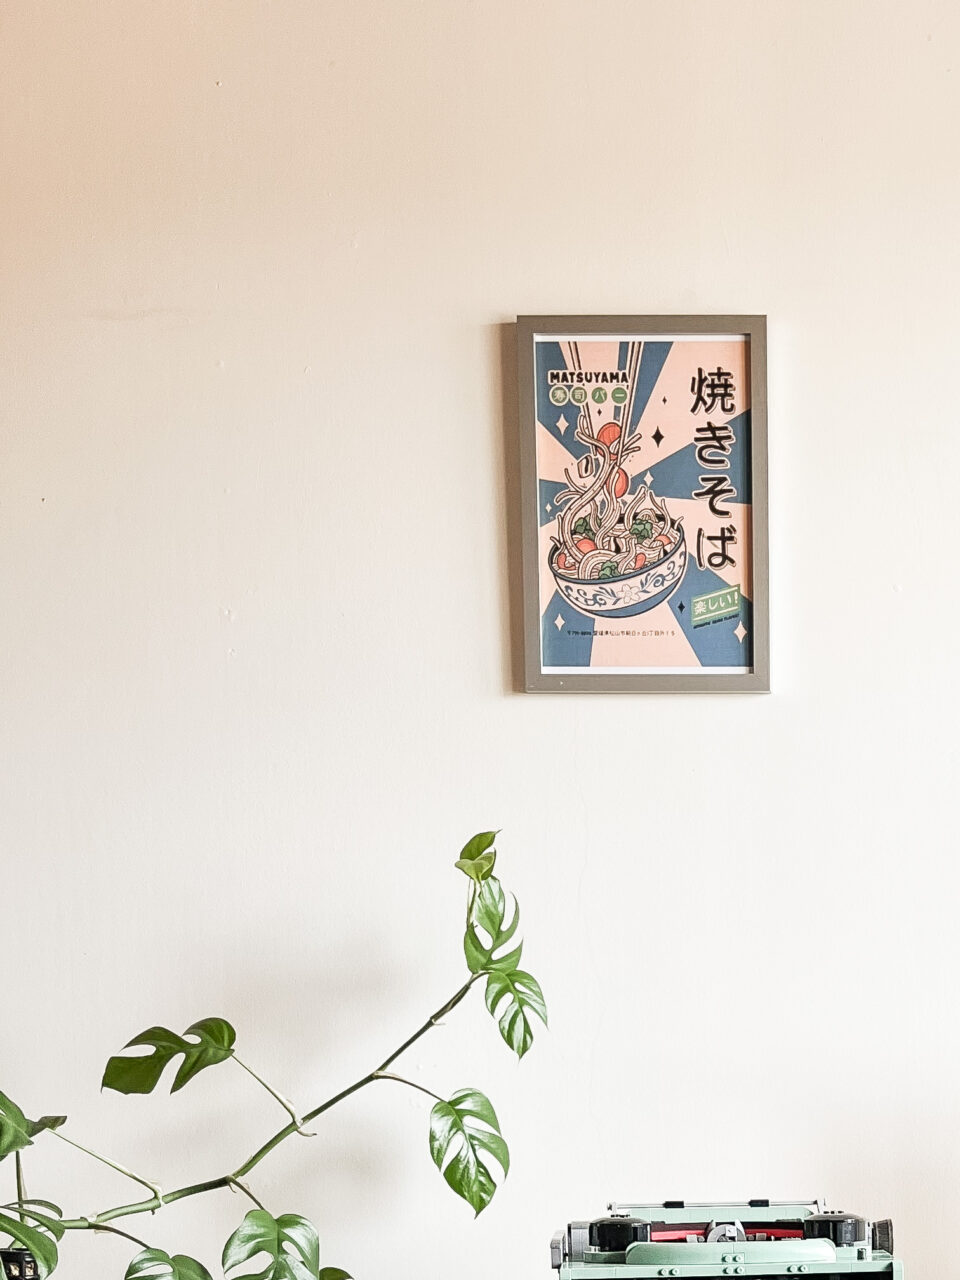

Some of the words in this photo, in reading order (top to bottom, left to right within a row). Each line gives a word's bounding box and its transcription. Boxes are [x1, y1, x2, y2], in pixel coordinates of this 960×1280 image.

[550, 372, 628, 383] MATSUYAMA
[690, 367, 736, 568] 焼きそば
